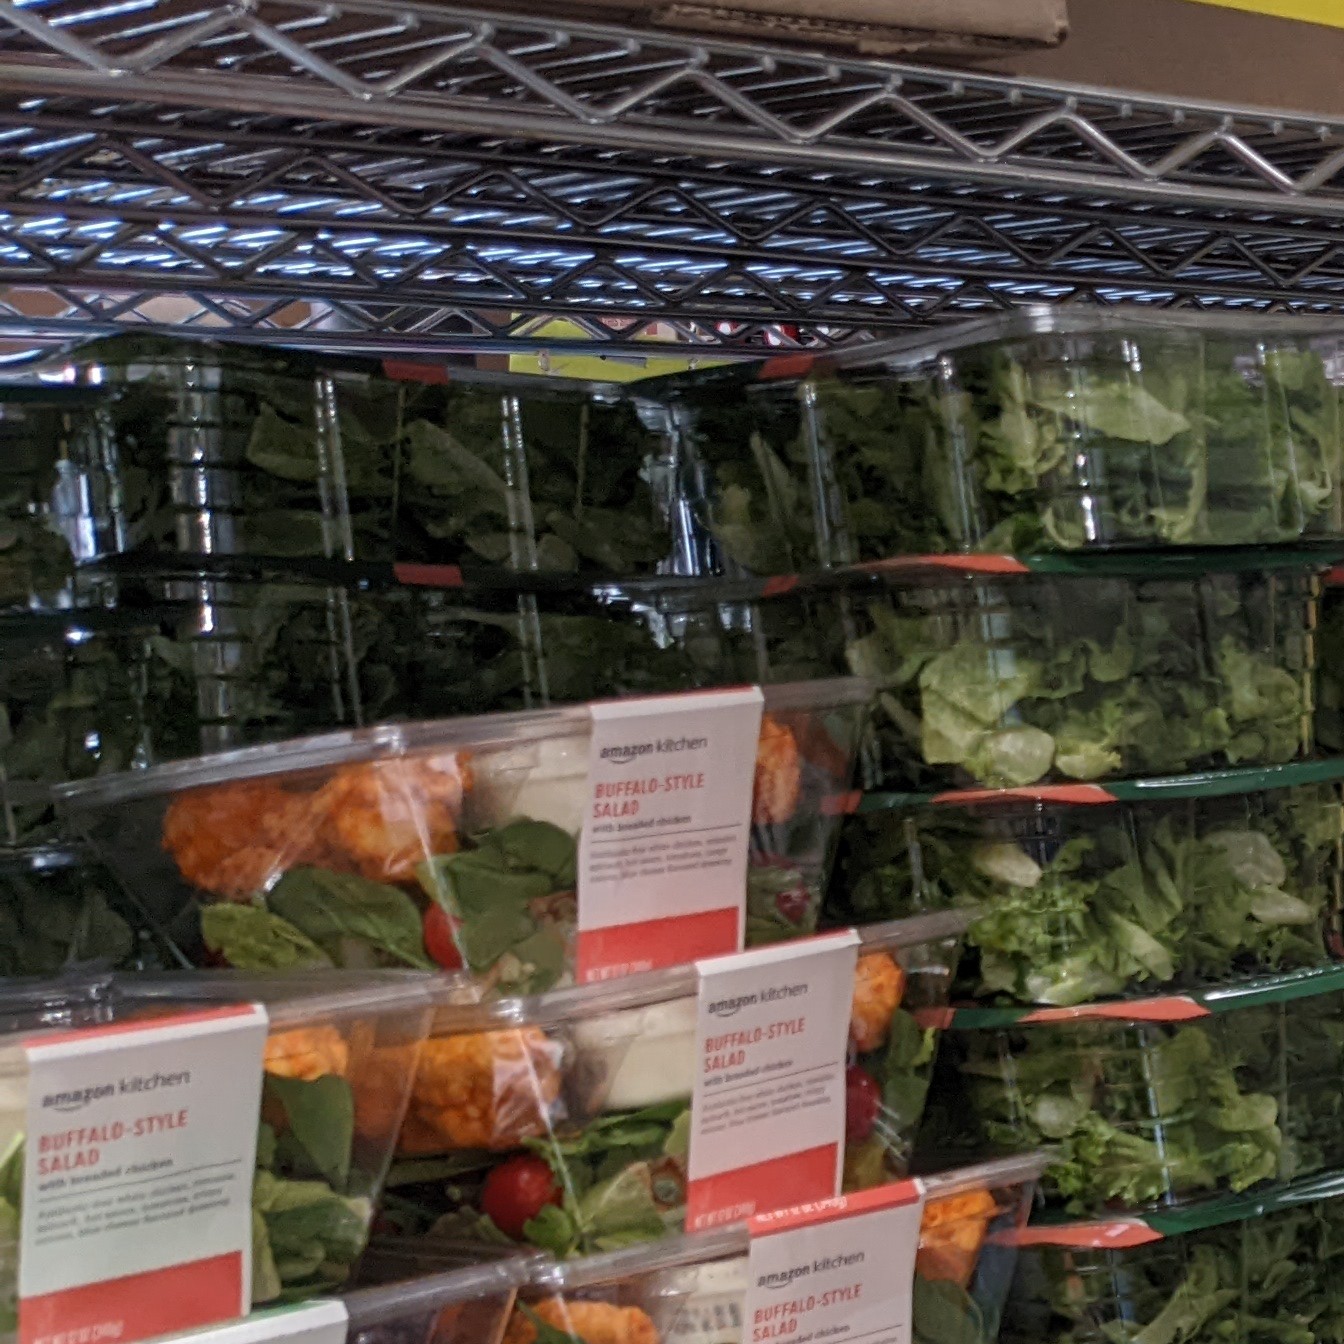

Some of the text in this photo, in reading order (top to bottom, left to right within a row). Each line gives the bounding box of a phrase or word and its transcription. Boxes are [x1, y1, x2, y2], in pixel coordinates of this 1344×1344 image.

[600, 736, 709, 761] amazon kitchen
[595, 774, 705, 799] BUFFALO-STYLE
[593, 800, 639, 818] SALAD
[708, 983, 809, 1015] amazon kitchen
[705, 1017, 806, 1053] BUFFALO-STYLE
[704, 1050, 746, 1074] SALAD
[42, 1070, 191, 1109] amazon kitchen
[38, 1110, 189, 1152] BUFFALO-STYLE
[37, 1150, 100, 1176] SALAD
[757, 1251, 865, 1288] amazon kitchen
[753, 1283, 863, 1325] BUFFALO-STYLE
[752, 1317, 798, 1343] SALAD
